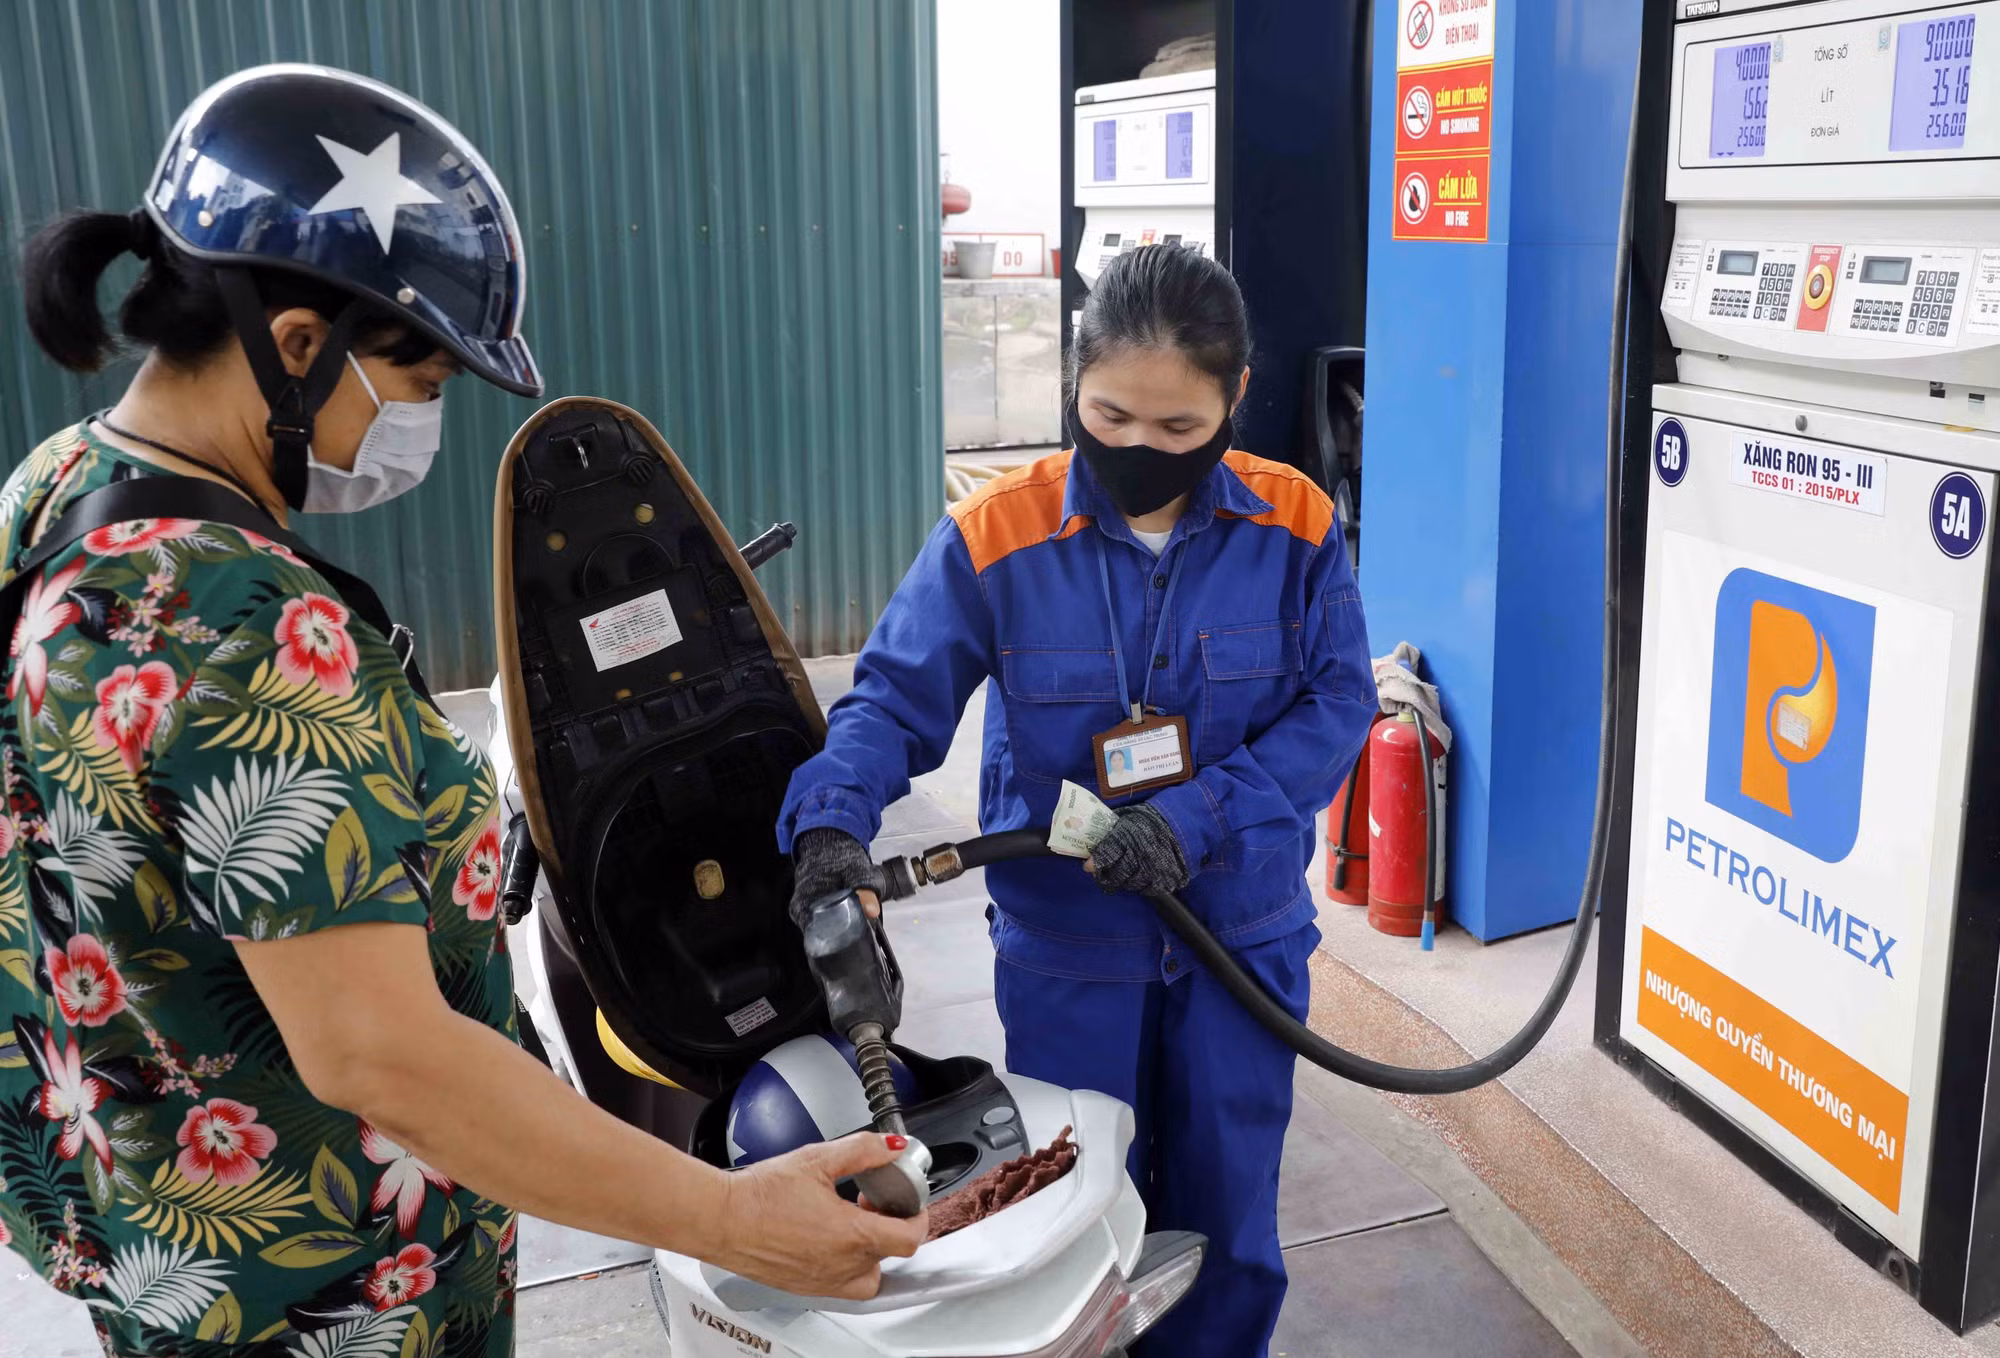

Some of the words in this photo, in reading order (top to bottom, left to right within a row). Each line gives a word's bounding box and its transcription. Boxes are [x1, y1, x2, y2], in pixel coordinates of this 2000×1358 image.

[1687, 1, 1719, 16] TATSUNO
[1445, 23, 1459, 48] ĐIỆN
[1461, 22, 1479, 45] THOẠI
[1924, 18, 1975, 62] 90000
[1736, 45, 1771, 81] 40000
[1837, 43, 1848, 59] SỐ
[1440, 119, 1450, 135] NO
[1450, 116, 1480, 134] SMOKING
[1737, 125, 1766, 147] 25600
[1827, 123, 1840, 136] GIÁ
[1926, 111, 1967, 138] 25600
[1438, 170, 1459, 199] CẤM
[1460, 170, 1478, 199] LỬA
[1445, 211, 1454, 226] NO
[1455, 211, 1469, 226] FIRE
[1661, 434, 1681, 471] 5B
[1743, 440, 1782, 471] XĂNG
[1787, 451, 1817, 478] RON
[1822, 457, 1841, 482] 95
[1857, 464, 1873, 489] III
[1752, 471, 1779, 488] TCCS
[1782, 477, 1794, 491] 01
[1805, 482, 1860, 505] 2015/PLX
[1941, 492, 1971, 540] 5A
[1665, 817, 1897, 980] PETROLIMEX
[1645, 970, 1712, 1030] NHƯỢNG
[1715, 1016, 1773, 1072] QUYỀN
[1777, 1056, 1854, 1128] THƯƠNG
[1857, 1116, 1896, 1161] MẠI
[689, 1302, 772, 1354] VISION
